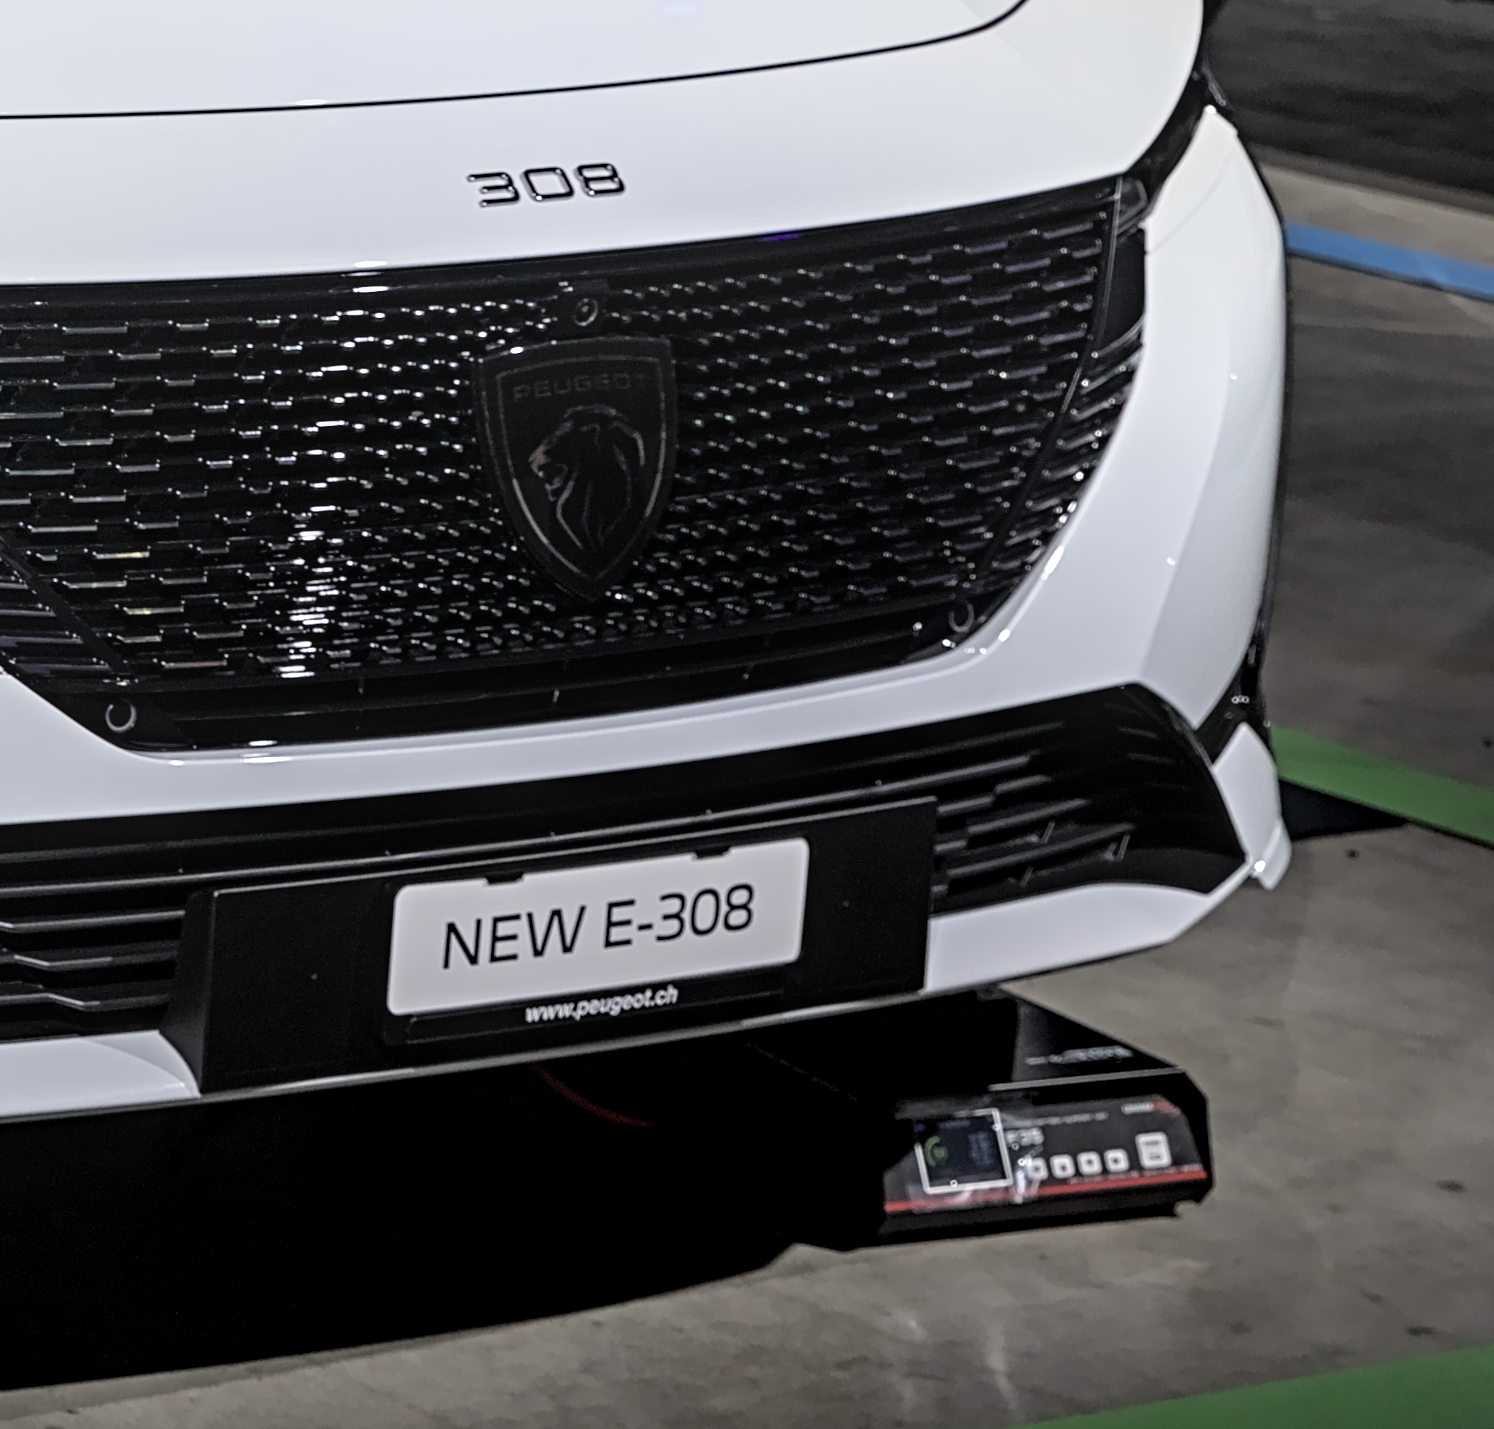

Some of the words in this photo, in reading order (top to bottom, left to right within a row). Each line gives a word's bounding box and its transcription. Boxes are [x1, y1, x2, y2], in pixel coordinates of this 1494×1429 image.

[465, 162, 626, 208] 308
[441, 904, 588, 970] NEW
[603, 882, 755, 950] E-308
[524, 983, 679, 1023] www.peugeot.ch
